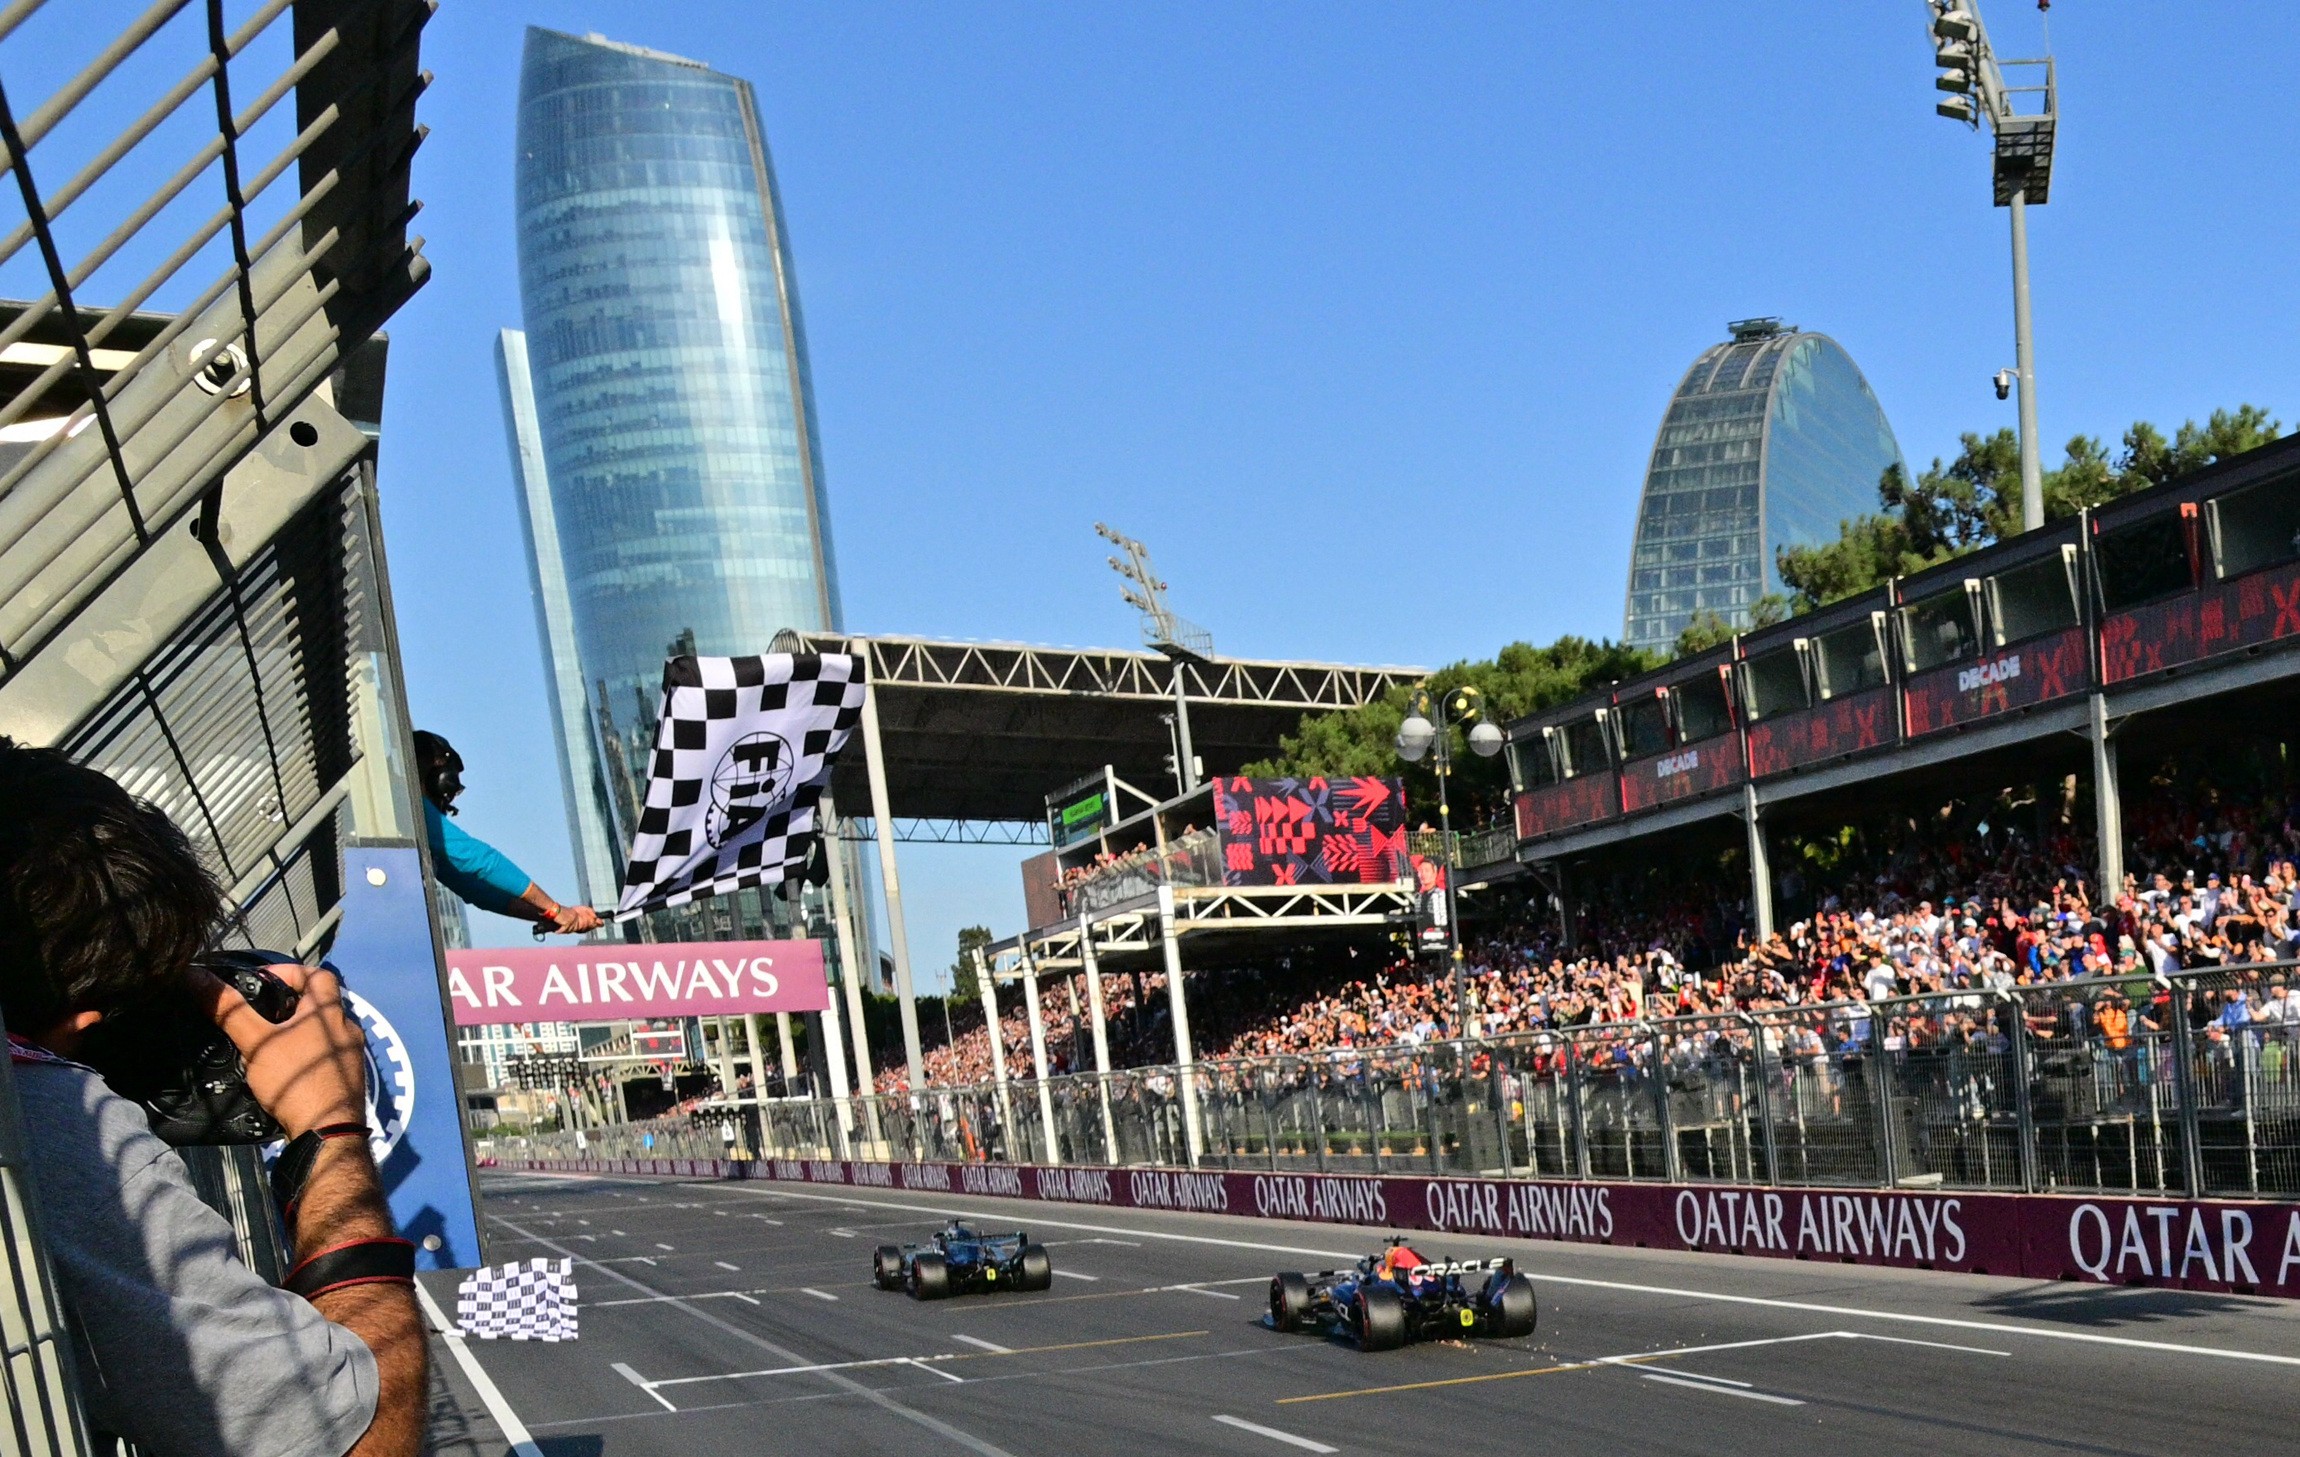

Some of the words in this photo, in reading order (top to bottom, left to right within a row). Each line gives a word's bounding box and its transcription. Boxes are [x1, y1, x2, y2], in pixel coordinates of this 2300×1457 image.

[1959, 655, 2020, 691] DECADE
[538, 957, 779, 1005] AIRWAYS
[962, 1166, 988, 1193] QATAR
[1037, 1168, 1069, 1199] QATAR
[1070, 1170, 1111, 1201] AIRWAYS
[1130, 1172, 1172, 1206] QATAR
[1173, 1173, 1228, 1210] AIRWAYS
[1254, 1176, 1309, 1217] QATAR
[1312, 1178, 1386, 1222] AIRWAYS
[1426, 1182, 1501, 1231] QATAR
[1508, 1184, 1613, 1238] AIRWAYS
[1676, 1190, 1789, 1250] QATAR
[1798, 1194, 1966, 1262] AIRWAYS
[2069, 1203, 2261, 1284] QATAR
[1411, 1257, 1505, 1277] ORACLE
